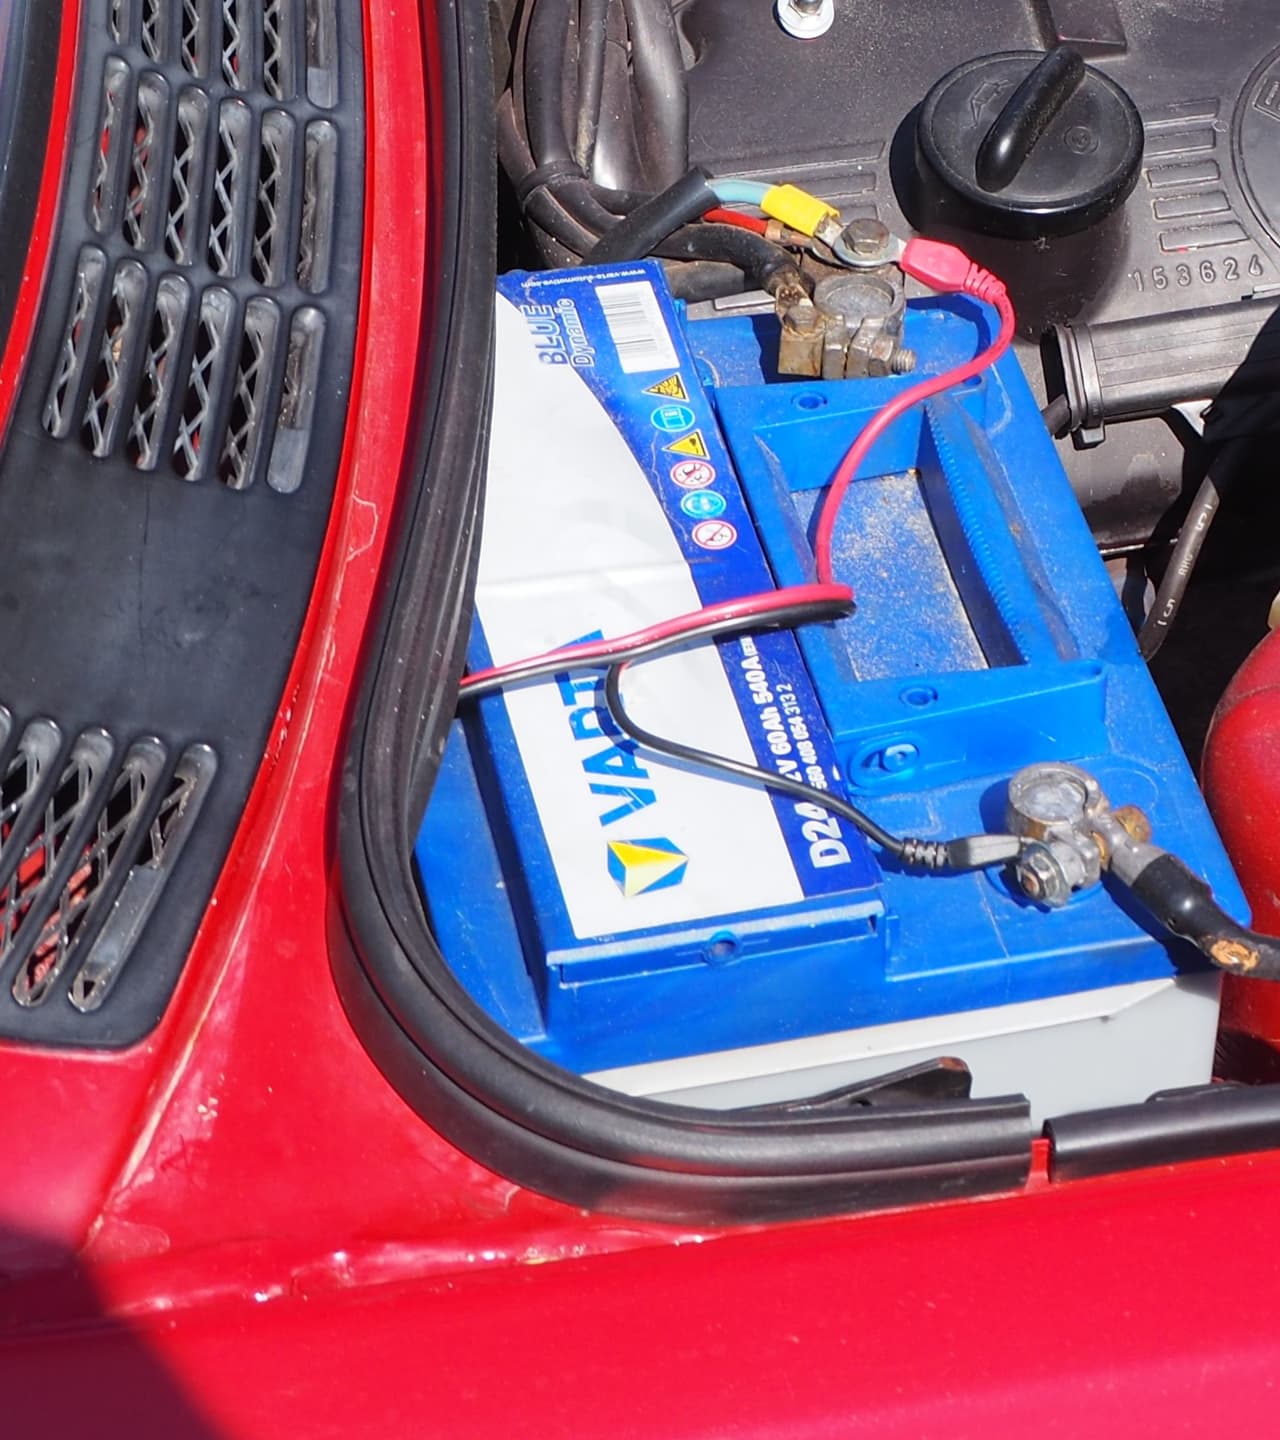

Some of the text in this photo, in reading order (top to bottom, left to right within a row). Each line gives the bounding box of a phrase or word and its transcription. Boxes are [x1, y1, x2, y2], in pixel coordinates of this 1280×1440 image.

[1130, 253, 1264, 292] 153624
[519, 304, 568, 364] BLUE
[554, 298, 596, 367] Dynamic
[776, 682, 793, 693] 2
[780, 693, 801, 716] 313
[760, 706, 792, 755] 60Ah
[796, 740, 818, 765] 408
